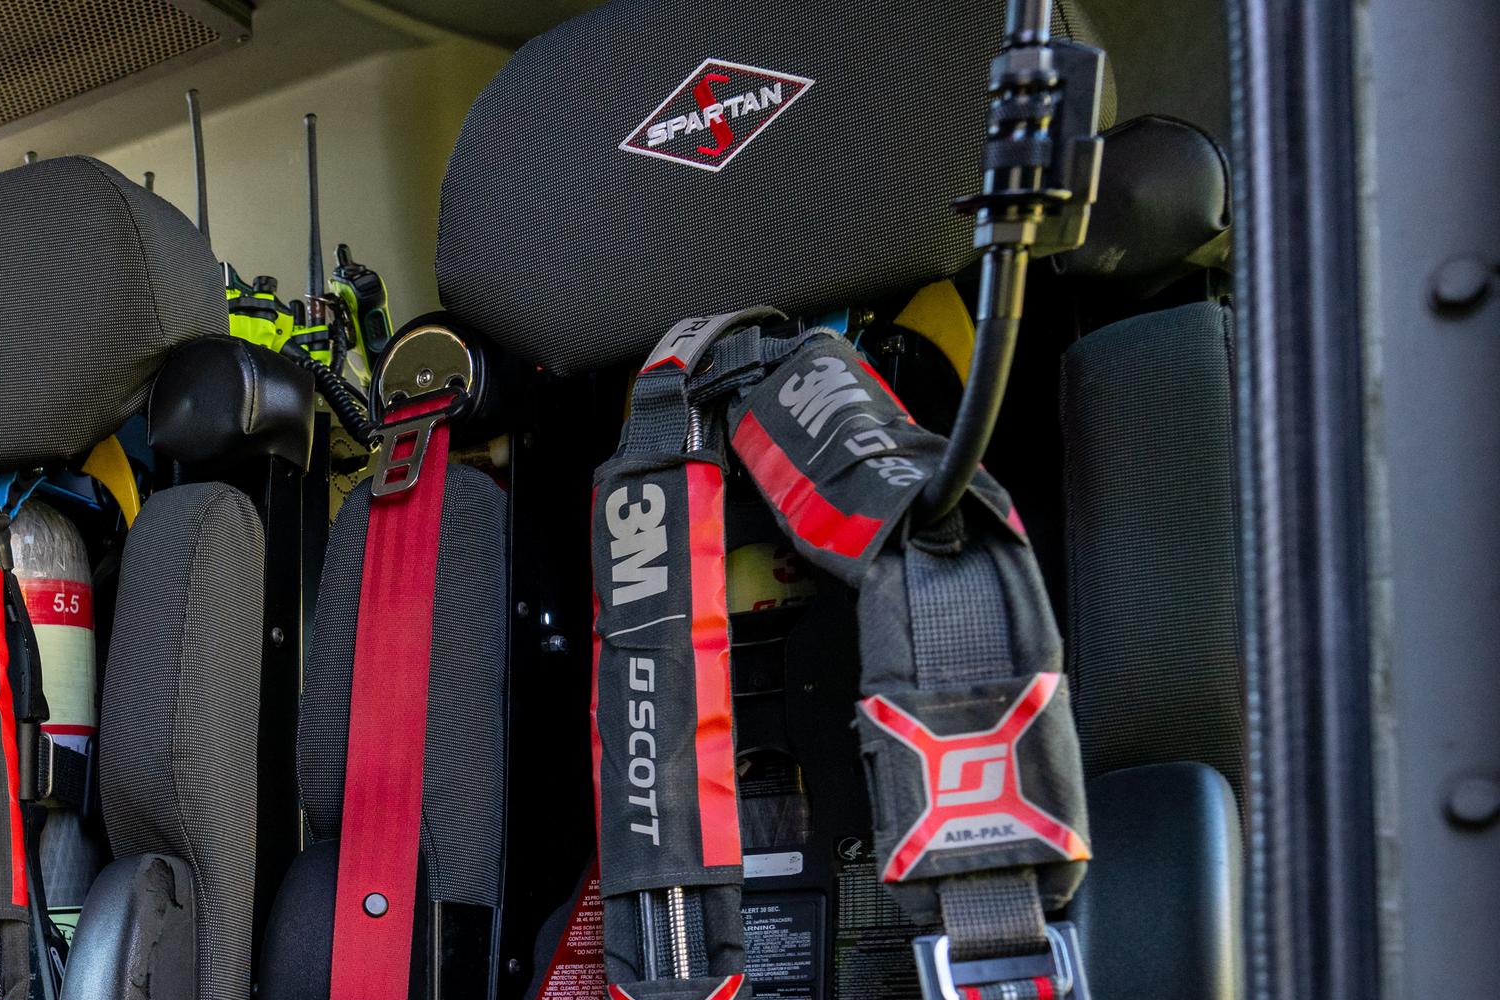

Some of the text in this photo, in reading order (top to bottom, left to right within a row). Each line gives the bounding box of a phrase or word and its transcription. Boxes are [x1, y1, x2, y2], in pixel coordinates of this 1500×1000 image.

[647, 82, 782, 147] SPARTAN
[778, 357, 873, 439] 3M
[53, 593, 80, 614] 5.5
[605, 484, 669, 846] 3M SCOTT
[945, 823, 1017, 842] AIR-PAK
